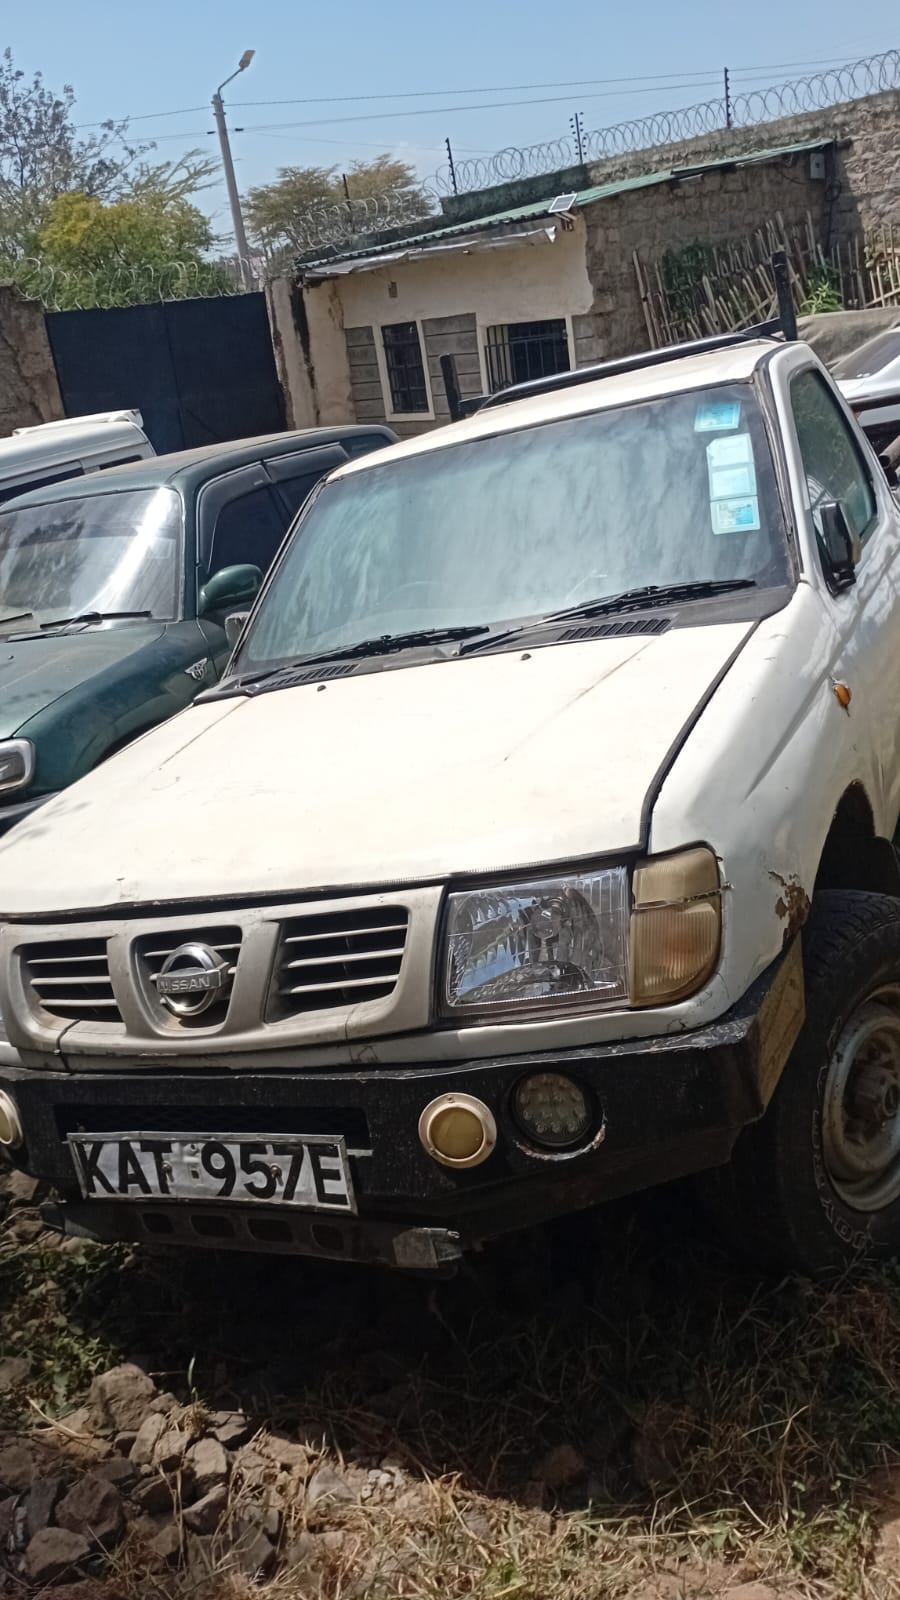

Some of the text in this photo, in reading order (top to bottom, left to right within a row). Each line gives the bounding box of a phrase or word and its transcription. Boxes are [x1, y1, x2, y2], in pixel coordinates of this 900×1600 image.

[159, 977, 210, 991] NISSAN
[75, 1140, 349, 1205] KAT 957E
